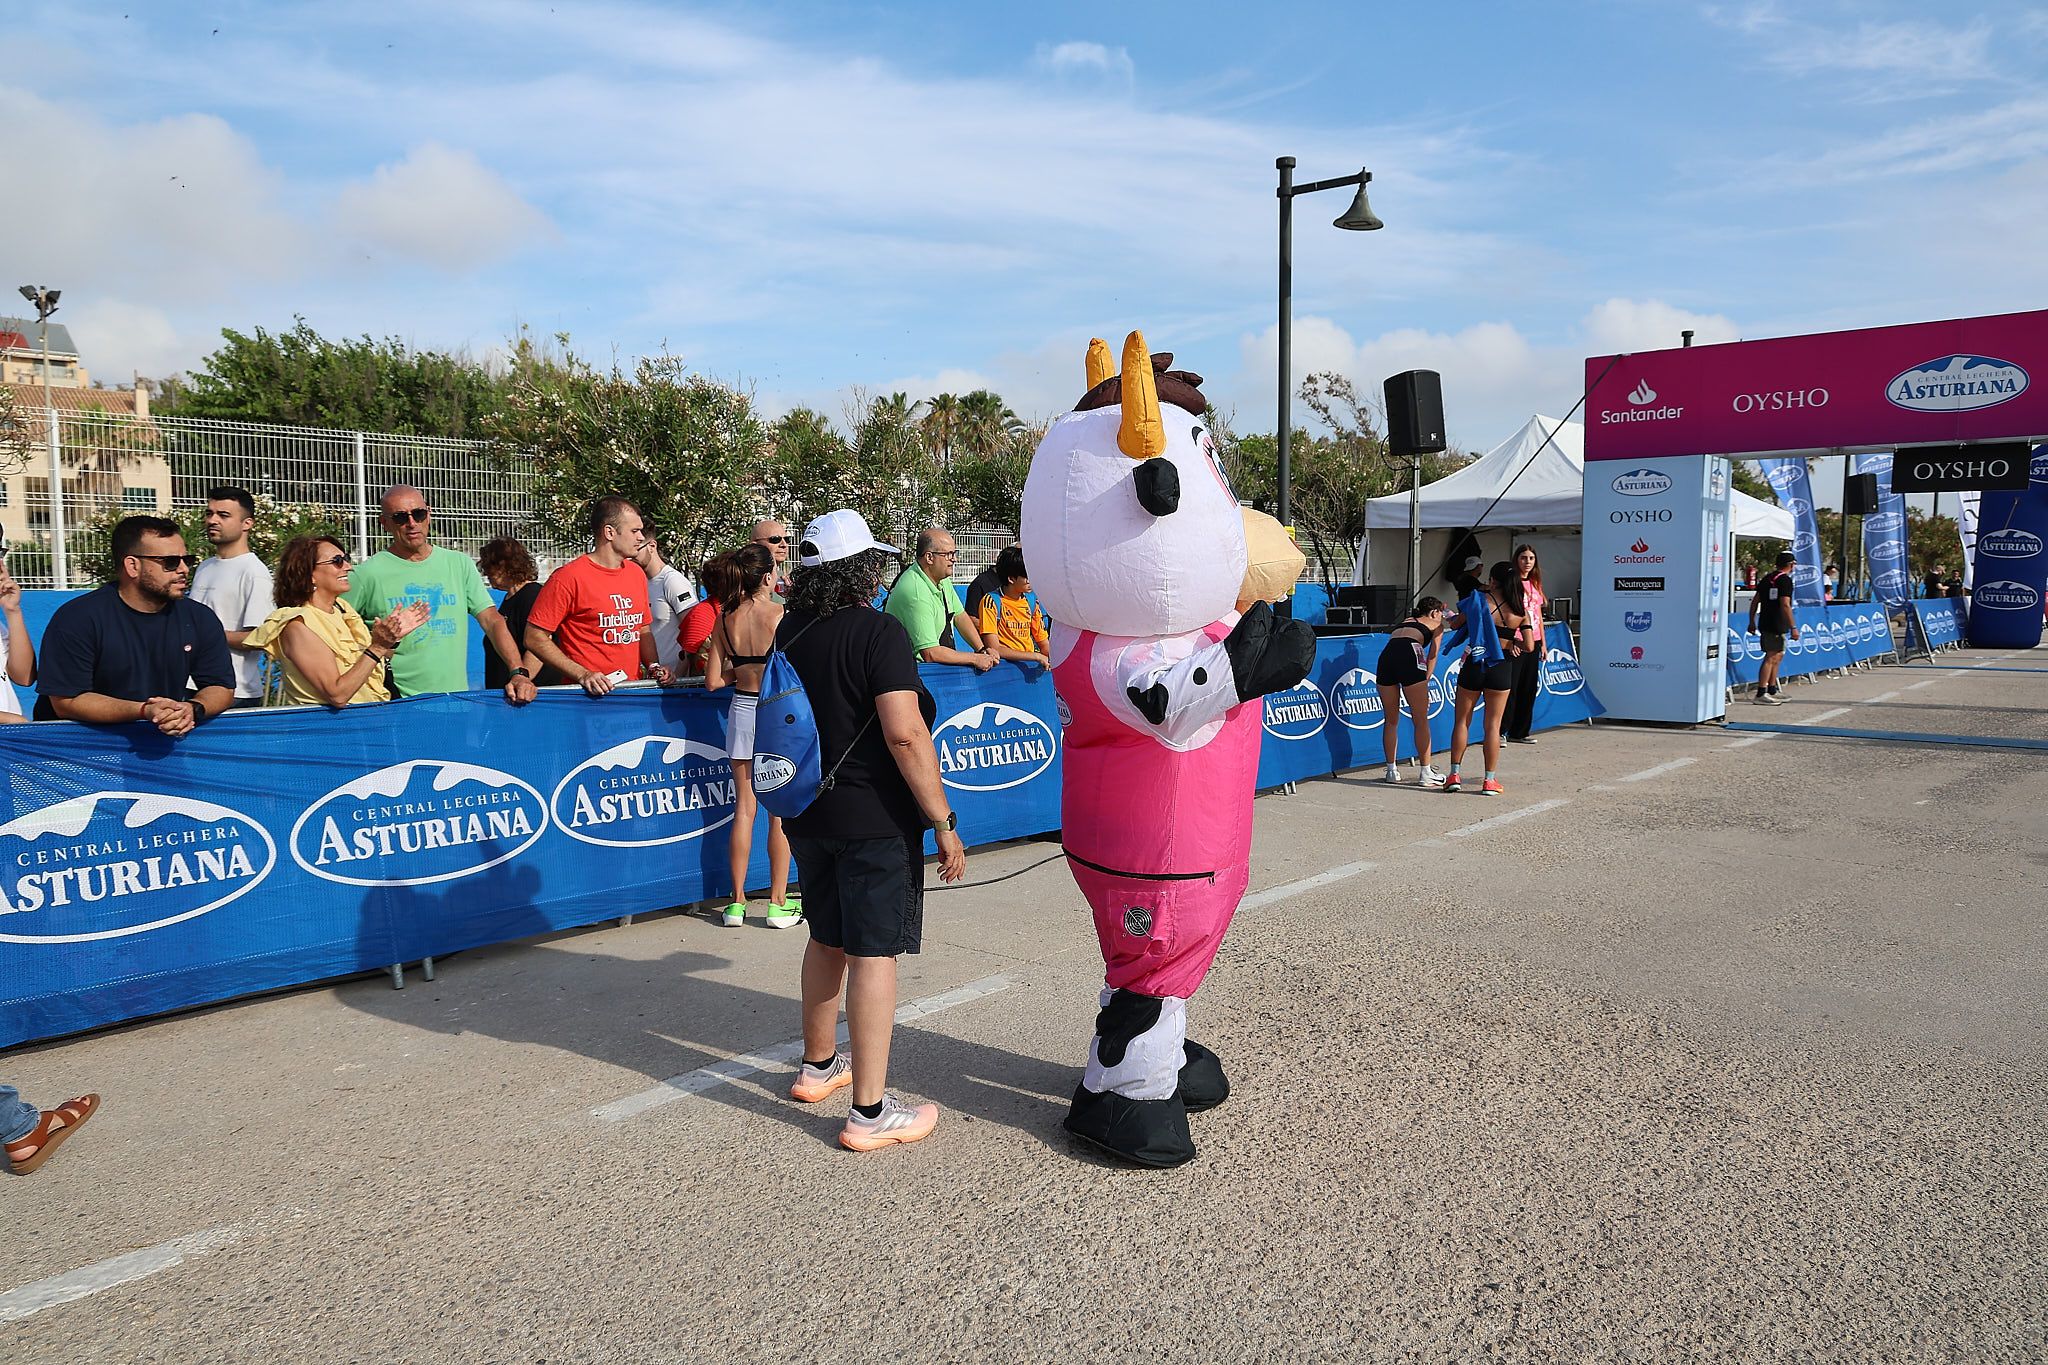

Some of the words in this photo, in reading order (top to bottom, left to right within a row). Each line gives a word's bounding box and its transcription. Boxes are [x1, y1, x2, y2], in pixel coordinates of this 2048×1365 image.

[1917, 374, 1962, 383] CENTRAL
[1966, 370, 2014, 379] LECHERA
[1896, 378, 2018, 400] ASTURIANA
[1732, 388, 1830, 413] OYSHO
[1601, 406, 1684, 424] Santander
[1913, 459, 2010, 480] OYSHO
[1616, 480, 1668, 491] ASTURIANA
[1610, 509, 1673, 524] OYSHO
[1981, 540, 2039, 552] ASTURIANA
[1614, 555, 1666, 564] Santander
[1617, 579, 1662, 590] Neutrogena
[609, 594, 633, 610] The
[1977, 590, 2034, 604] ASTURIANA
[598, 610, 643, 630] Intelligen
[1609, 662, 1639, 670] octopus
[1273, 694, 1297, 705] CENTRAL
[1337, 692, 1384, 716] ASTURIAN
[1265, 700, 1326, 726] ASTURIANA
[955, 732, 998, 744] CENTRAL
[1001, 727, 1041, 740] LECHERA
[940, 739, 1049, 773] ASTURIANA
[600, 773, 665, 790] CENTRAL
[670, 764, 732, 781] LECHERA
[755, 767, 790, 783] URIANA
[352, 801, 437, 822] CENTRAL
[444, 791, 521, 810] LECHERA
[314, 806, 534, 866] ASTURIANA
[17, 840, 127, 868] CENTRAL
[138, 826, 240, 851] LECHERA
